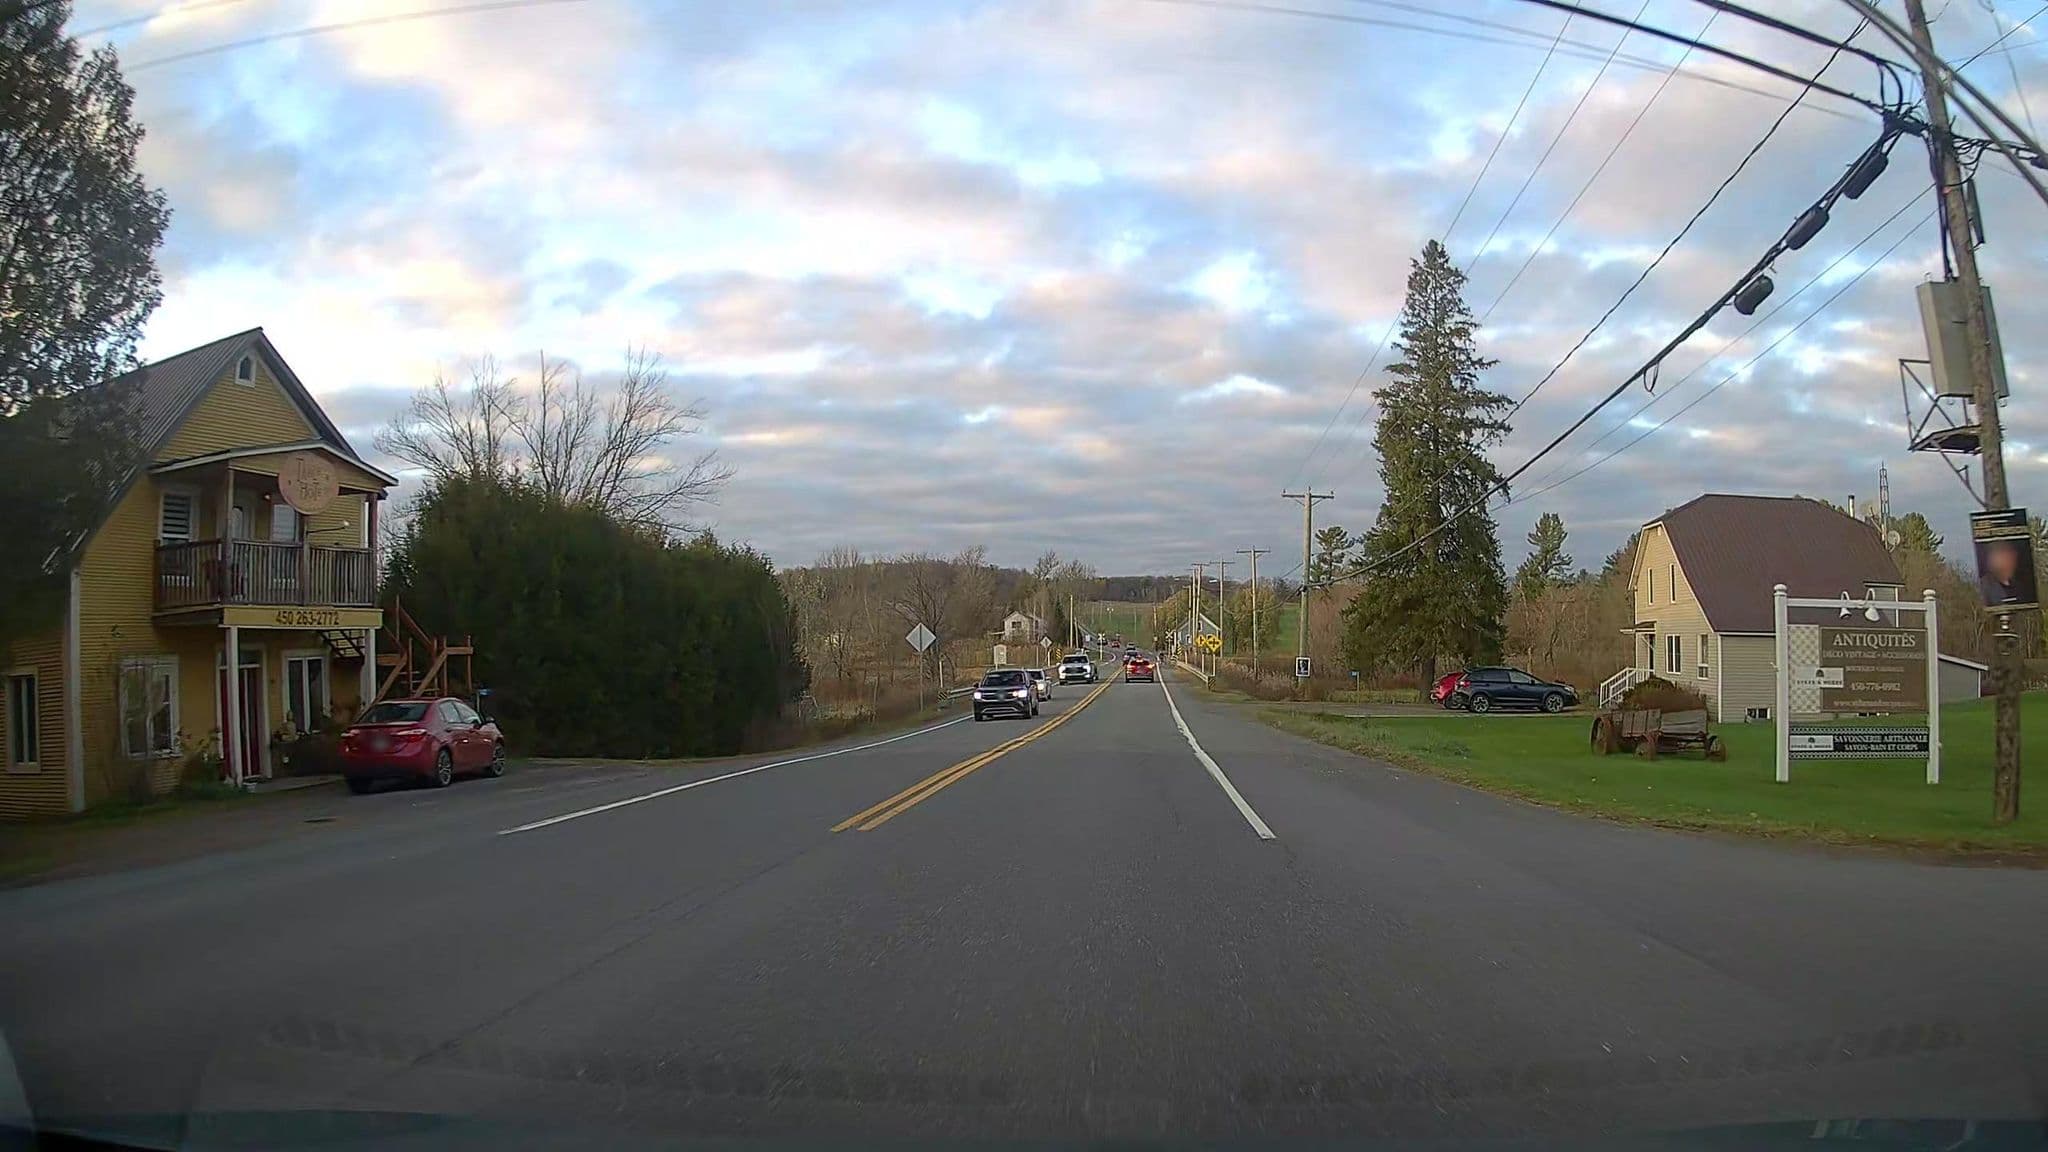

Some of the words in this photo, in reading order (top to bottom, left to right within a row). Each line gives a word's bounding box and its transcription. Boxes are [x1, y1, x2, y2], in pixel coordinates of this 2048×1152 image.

[275, 610, 294, 625] 450
[296, 610, 340, 626] 263-2772
[1832, 632, 1917, 649] ANTIQUITÉS
[1883, 735, 1928, 744] ARTISANALE
